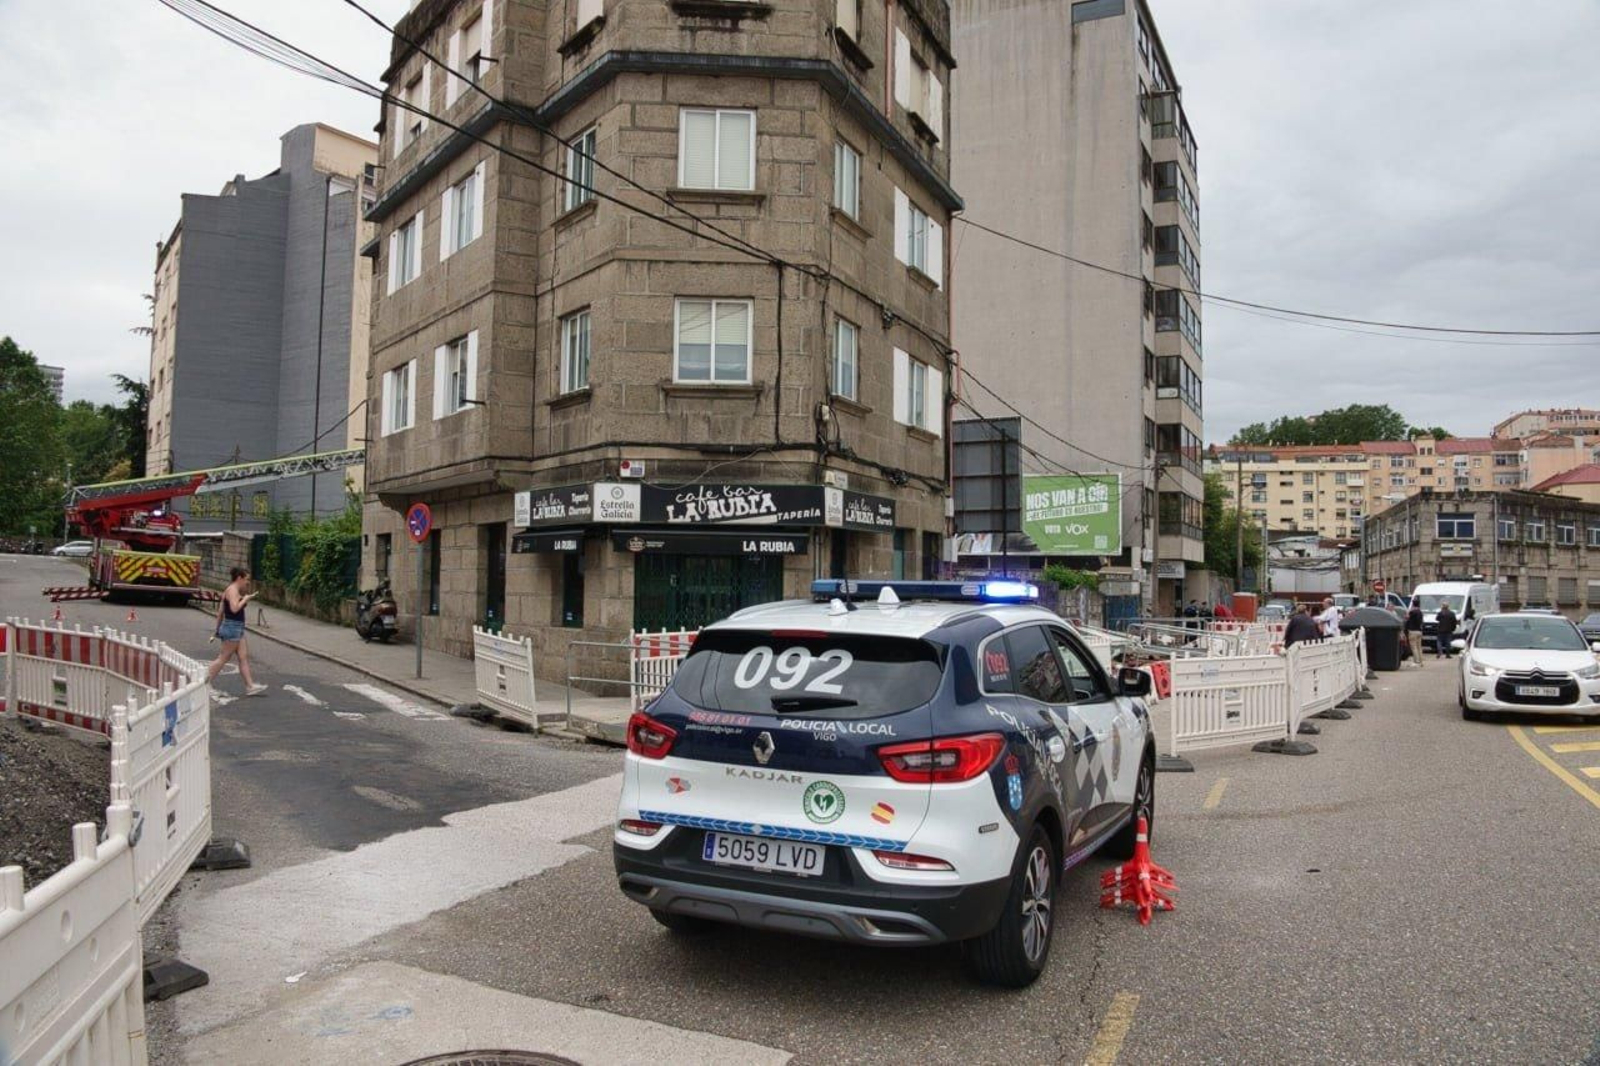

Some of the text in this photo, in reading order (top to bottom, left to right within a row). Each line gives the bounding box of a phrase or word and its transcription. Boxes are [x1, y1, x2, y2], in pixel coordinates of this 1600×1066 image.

[600, 499, 635, 510] Estrella
[1026, 492, 1050, 510] NOS
[1051, 488, 1076, 507] VAN
[1077, 487, 1086, 504] A
[600, 508, 634, 520] Galicia
[666, 493, 777, 523] LA RUBIA
[1065, 523, 1089, 535] VOX
[742, 541, 795, 552] LA RUBIA
[734, 646, 854, 694] 092
[812, 731, 837, 742] VIGO
[848, 722, 897, 737] LOCAL
[725, 766, 804, 784] KADJAR
[718, 836, 817, 870] 5059 LVD
